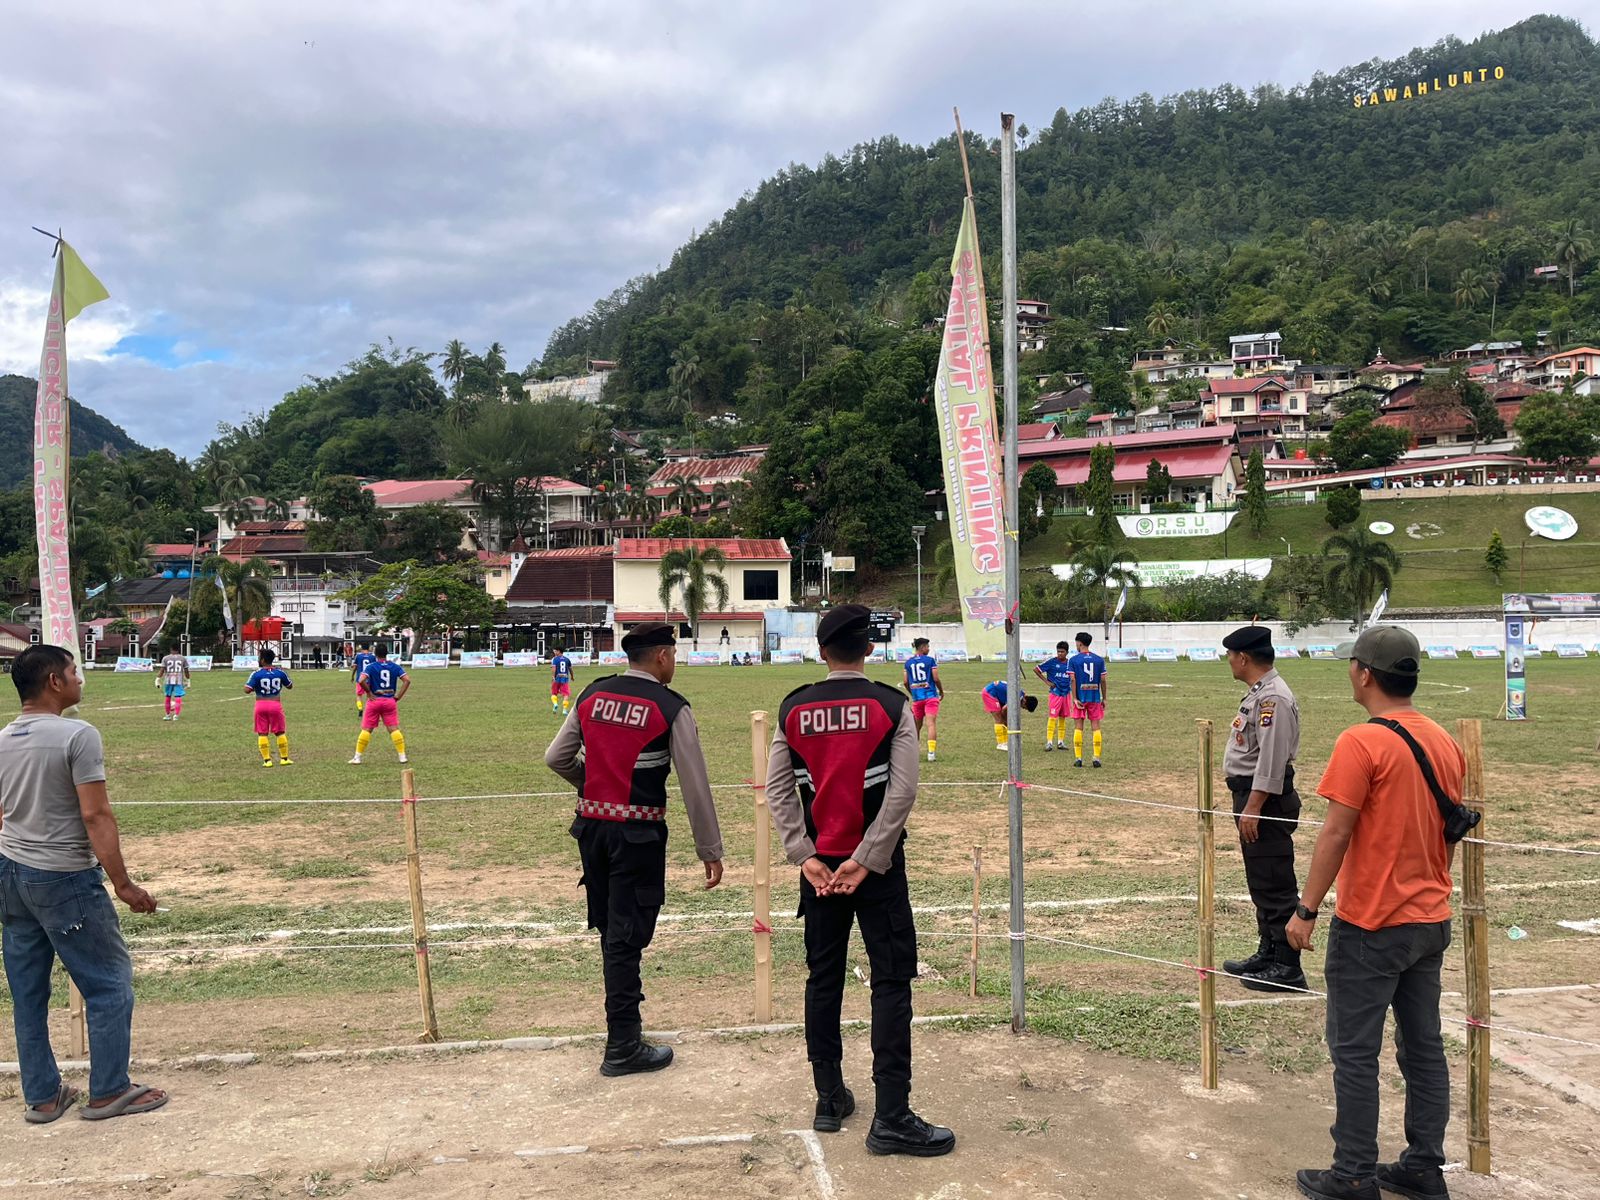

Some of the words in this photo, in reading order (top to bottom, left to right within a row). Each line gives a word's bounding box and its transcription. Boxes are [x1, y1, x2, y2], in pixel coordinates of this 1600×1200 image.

[1353, 66, 1504, 108] SAWAHLUNTO
[1392, 472, 1466, 489] RSUD
[1157, 516, 1204, 528] RSU
[166, 660, 182, 673] 26
[560, 661, 566, 673] 8
[910, 662, 927, 682] 16
[1083, 662, 1094, 682] 4
[260, 677, 281, 695] 99
[380, 669, 391, 688] 9
[591, 698, 650, 727] POLISI
[799, 705, 866, 735] POLISI
